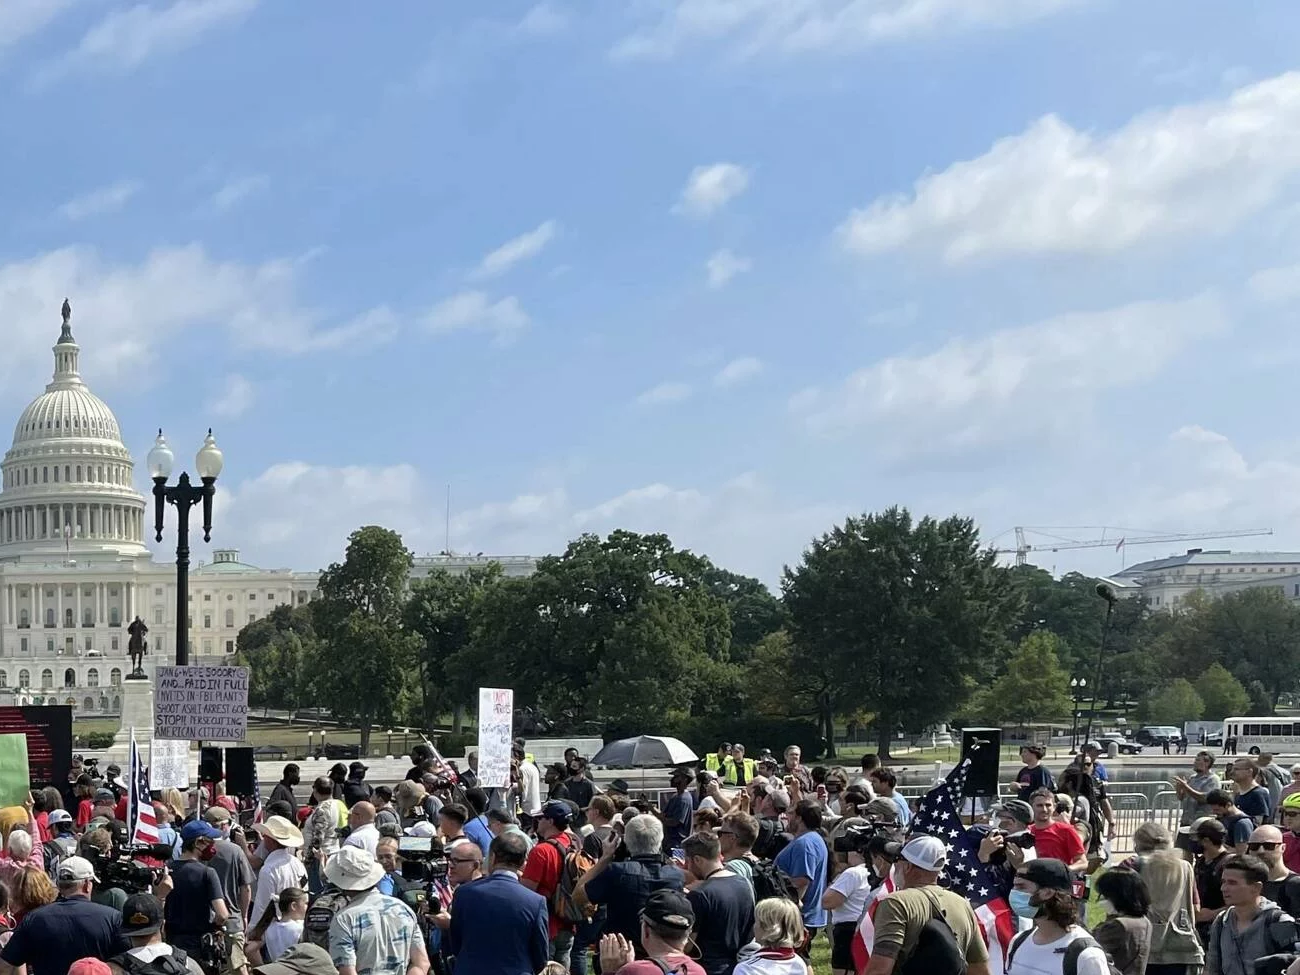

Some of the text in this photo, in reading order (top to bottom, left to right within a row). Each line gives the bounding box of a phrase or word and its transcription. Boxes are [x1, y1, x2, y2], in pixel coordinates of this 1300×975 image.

[223, 680, 248, 691] FULL
[157, 704, 180, 713] SHOOT
[232, 705, 248, 714] 600
[154, 726, 196, 738] AMERICAN
